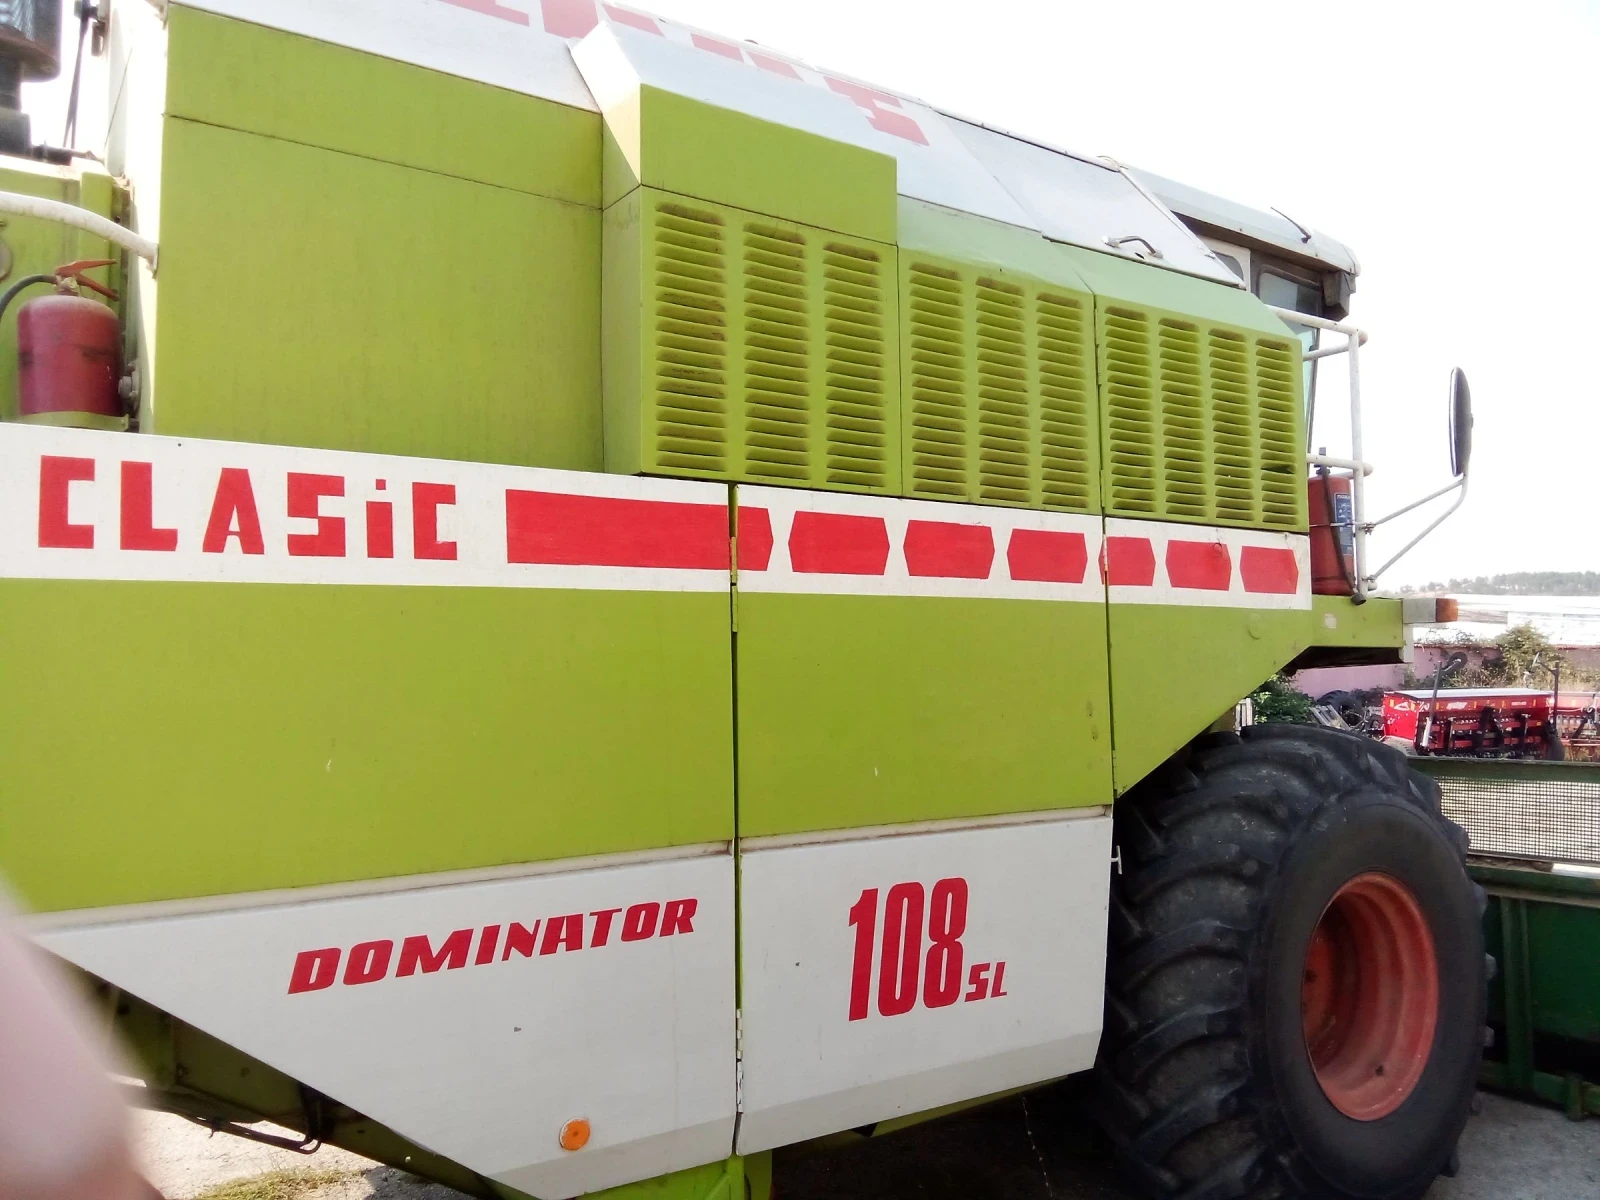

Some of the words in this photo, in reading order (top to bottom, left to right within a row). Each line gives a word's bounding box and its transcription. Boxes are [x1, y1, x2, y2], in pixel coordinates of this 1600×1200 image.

[287, 897, 699, 995] DOMINATOR
[848, 876, 969, 1022] 108
[964, 961, 1008, 1003] SL
